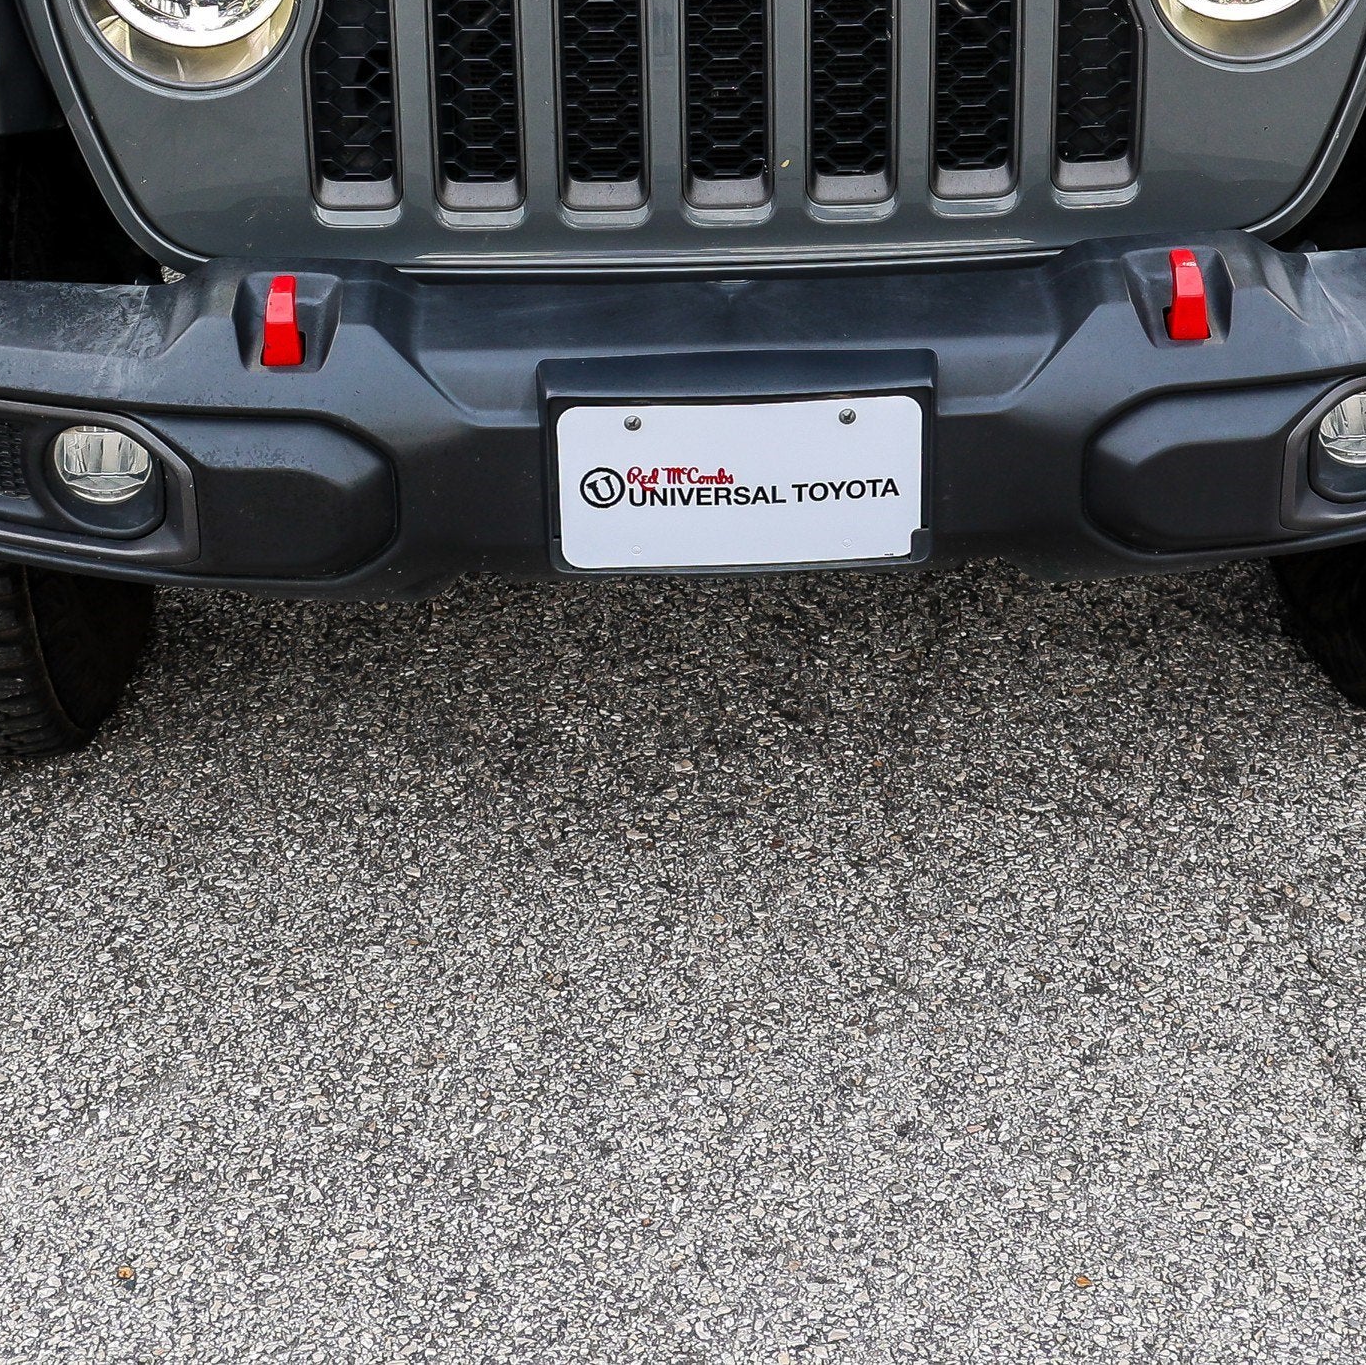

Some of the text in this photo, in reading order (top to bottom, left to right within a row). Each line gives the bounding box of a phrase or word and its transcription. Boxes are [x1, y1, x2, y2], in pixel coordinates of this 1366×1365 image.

[626, 466, 660, 492] Red
[628, 477, 900, 507] UNIVERSAL TOYOTA
